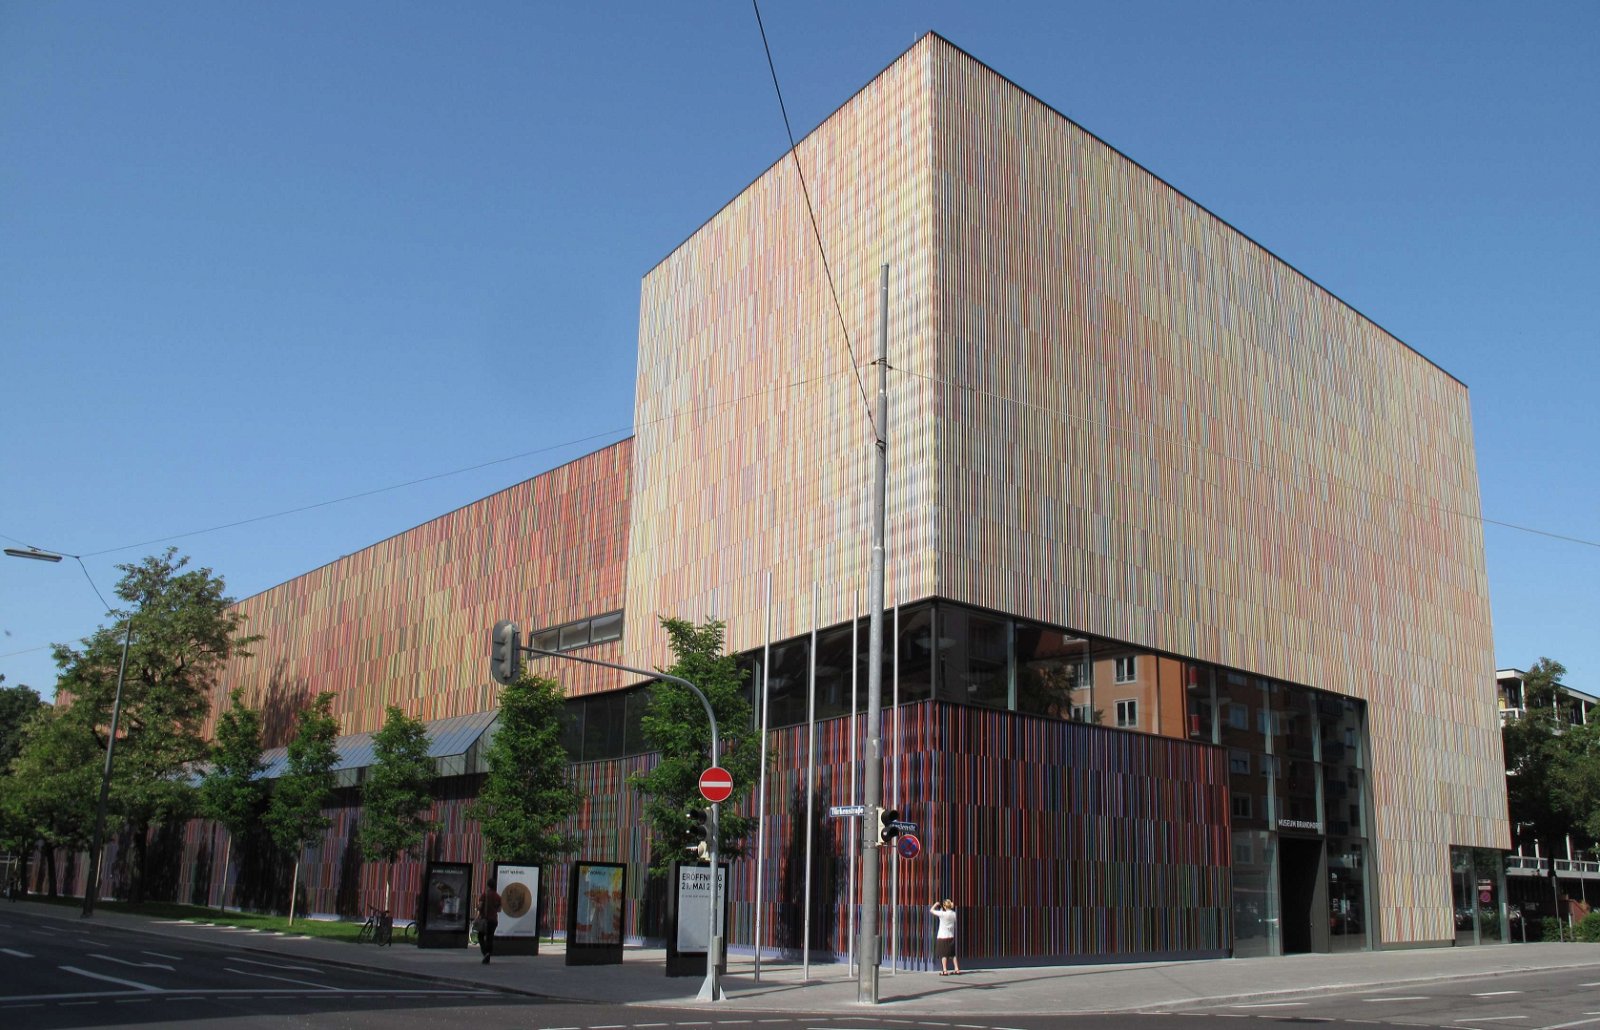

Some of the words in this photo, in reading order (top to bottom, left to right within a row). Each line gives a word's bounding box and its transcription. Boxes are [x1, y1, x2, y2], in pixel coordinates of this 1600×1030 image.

[1278, 819, 1296, 828] MUSEUM
[682, 872, 723, 882] ERÖFFNG
[692, 882, 706, 891] MAI
[706, 882, 723, 892] 29
